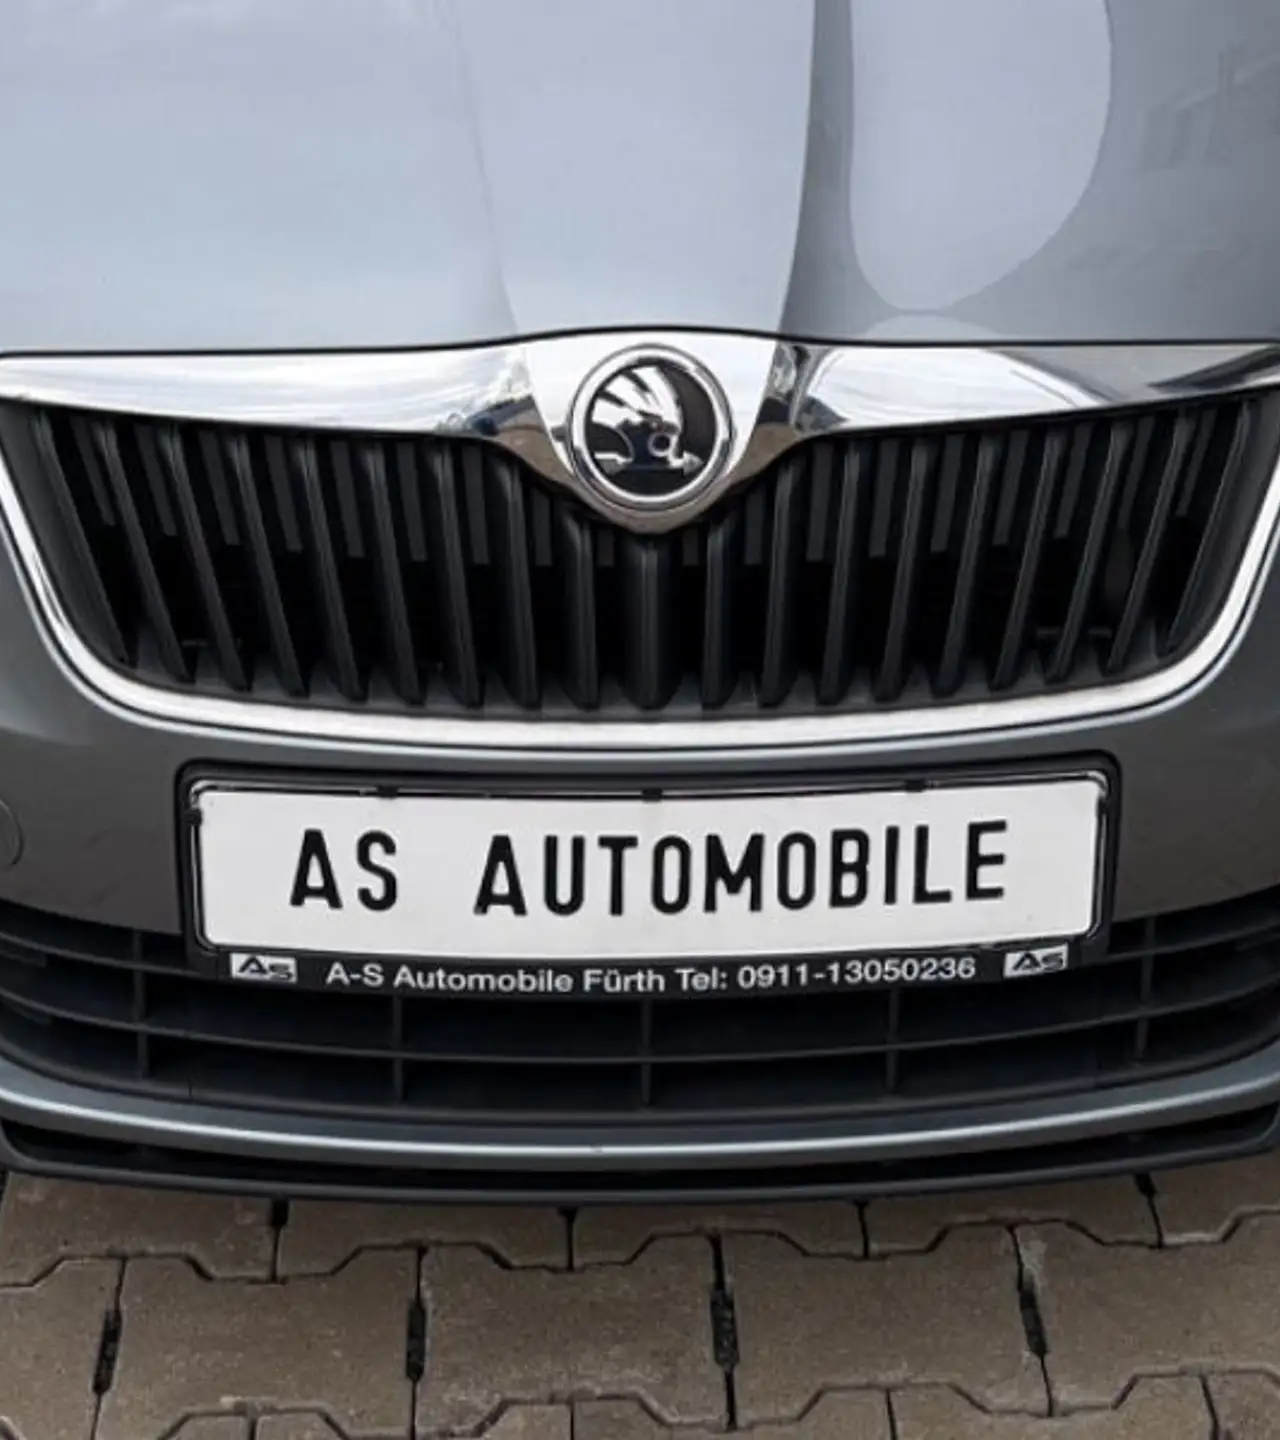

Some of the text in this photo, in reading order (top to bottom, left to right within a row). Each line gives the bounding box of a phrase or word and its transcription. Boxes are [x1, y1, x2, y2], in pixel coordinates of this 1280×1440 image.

[288, 819, 1008, 917] AS AUTOMOBILE
[324, 955, 977, 994] A-S Automobile Fürth Tel: 0911-13050236
